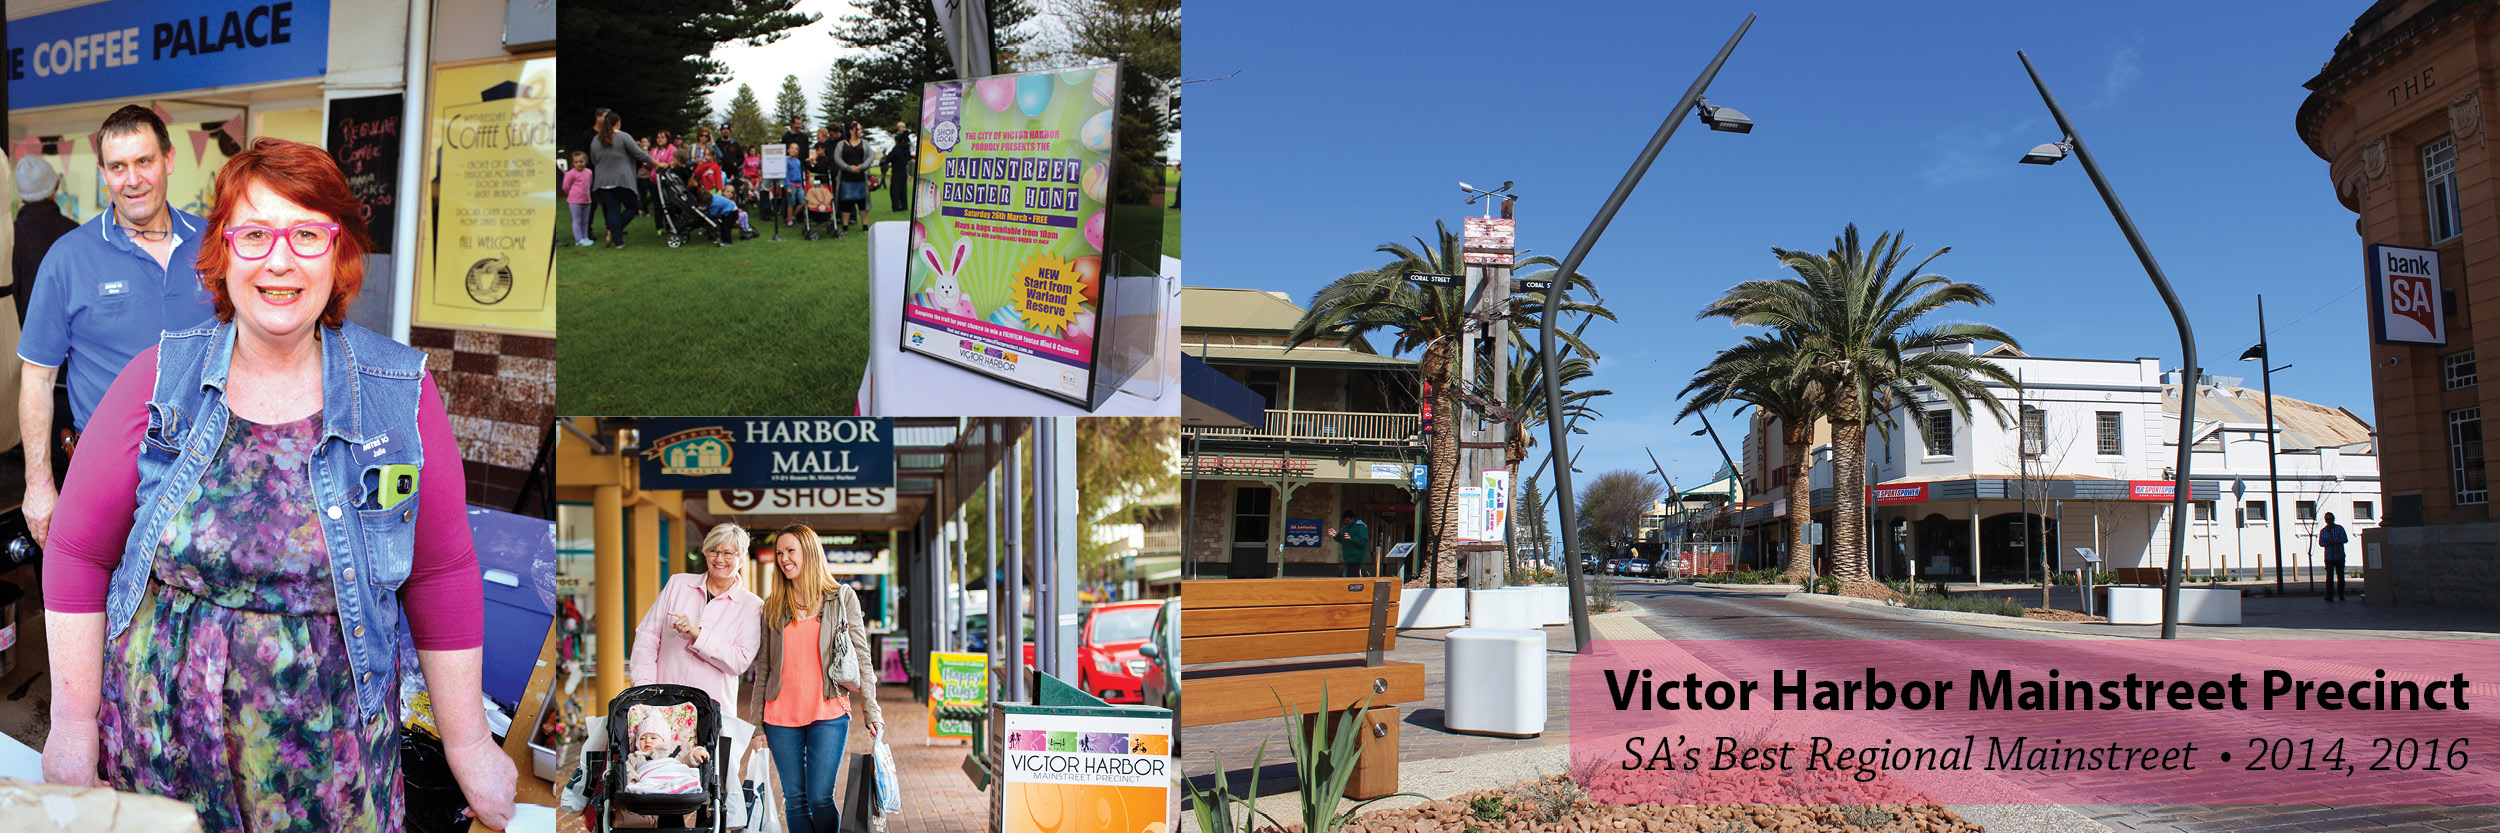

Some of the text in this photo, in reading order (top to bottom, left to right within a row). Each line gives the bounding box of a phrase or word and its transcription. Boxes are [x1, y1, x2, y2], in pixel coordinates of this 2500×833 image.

[33, 27, 140, 78] COFFEE
[153, 1, 294, 61] PALACE
[2387, 65, 2436, 107] THE
[447, 113, 499, 150] COFFEE
[937, 128, 955, 136] SHOP
[965, 130, 1060, 140] THE CITY OF VICTOR HARBOR
[971, 142, 1050, 151] PROUDLY PRESENTS THE
[946, 158, 1080, 182] MAINSTREET
[943, 184, 1078, 209] EASTER HUNT
[964, 208, 1048, 224] Saturday 26th March FREE
[954, 220, 971, 230] Maps
[976, 223, 991, 232] bags
[991, 225, 1022, 236] available
[1022, 228, 1039, 238] from
[1040, 230, 1059, 240] 10am
[2387, 251, 2431, 276] bank
[1038, 267, 1060, 281] NEW
[1410, 274, 1429, 282] CORAL
[1024, 276, 1073, 295] Start from
[2393, 278, 2431, 313] SA
[1026, 288, 1068, 306] Warland
[1026, 299, 1066, 317] Reserve
[915, 309, 934, 319] Complete
[941, 315, 950, 323] trail
[956, 319, 967, 328] your
[967, 321, 984, 332] chance
[1039, 339, 1052, 349] Mini
[1057, 344, 1079, 356] Camera
[959, 348, 984, 362] VICTOR
[984, 356, 1016, 373] HARBOR
[745, 419, 880, 444] HARBOR
[363, 438, 382, 452] MITRE
[380, 436, 390, 445] 10
[373, 447, 387, 458] Julie
[771, 450, 860, 474] MALL
[1199, 456, 1308, 470] GROSVENOR
[1414, 467, 1425, 479] P
[772, 488, 886, 508] SHOES
[1880, 488, 1920, 498] SPORTSPOWER
[942, 667, 984, 690] Happy
[945, 683, 980, 703] Rugs
[1011, 754, 1165, 777] VICTOR HARBOR
[1033, 772, 1141, 783] MAINSTREET PRECINCT
